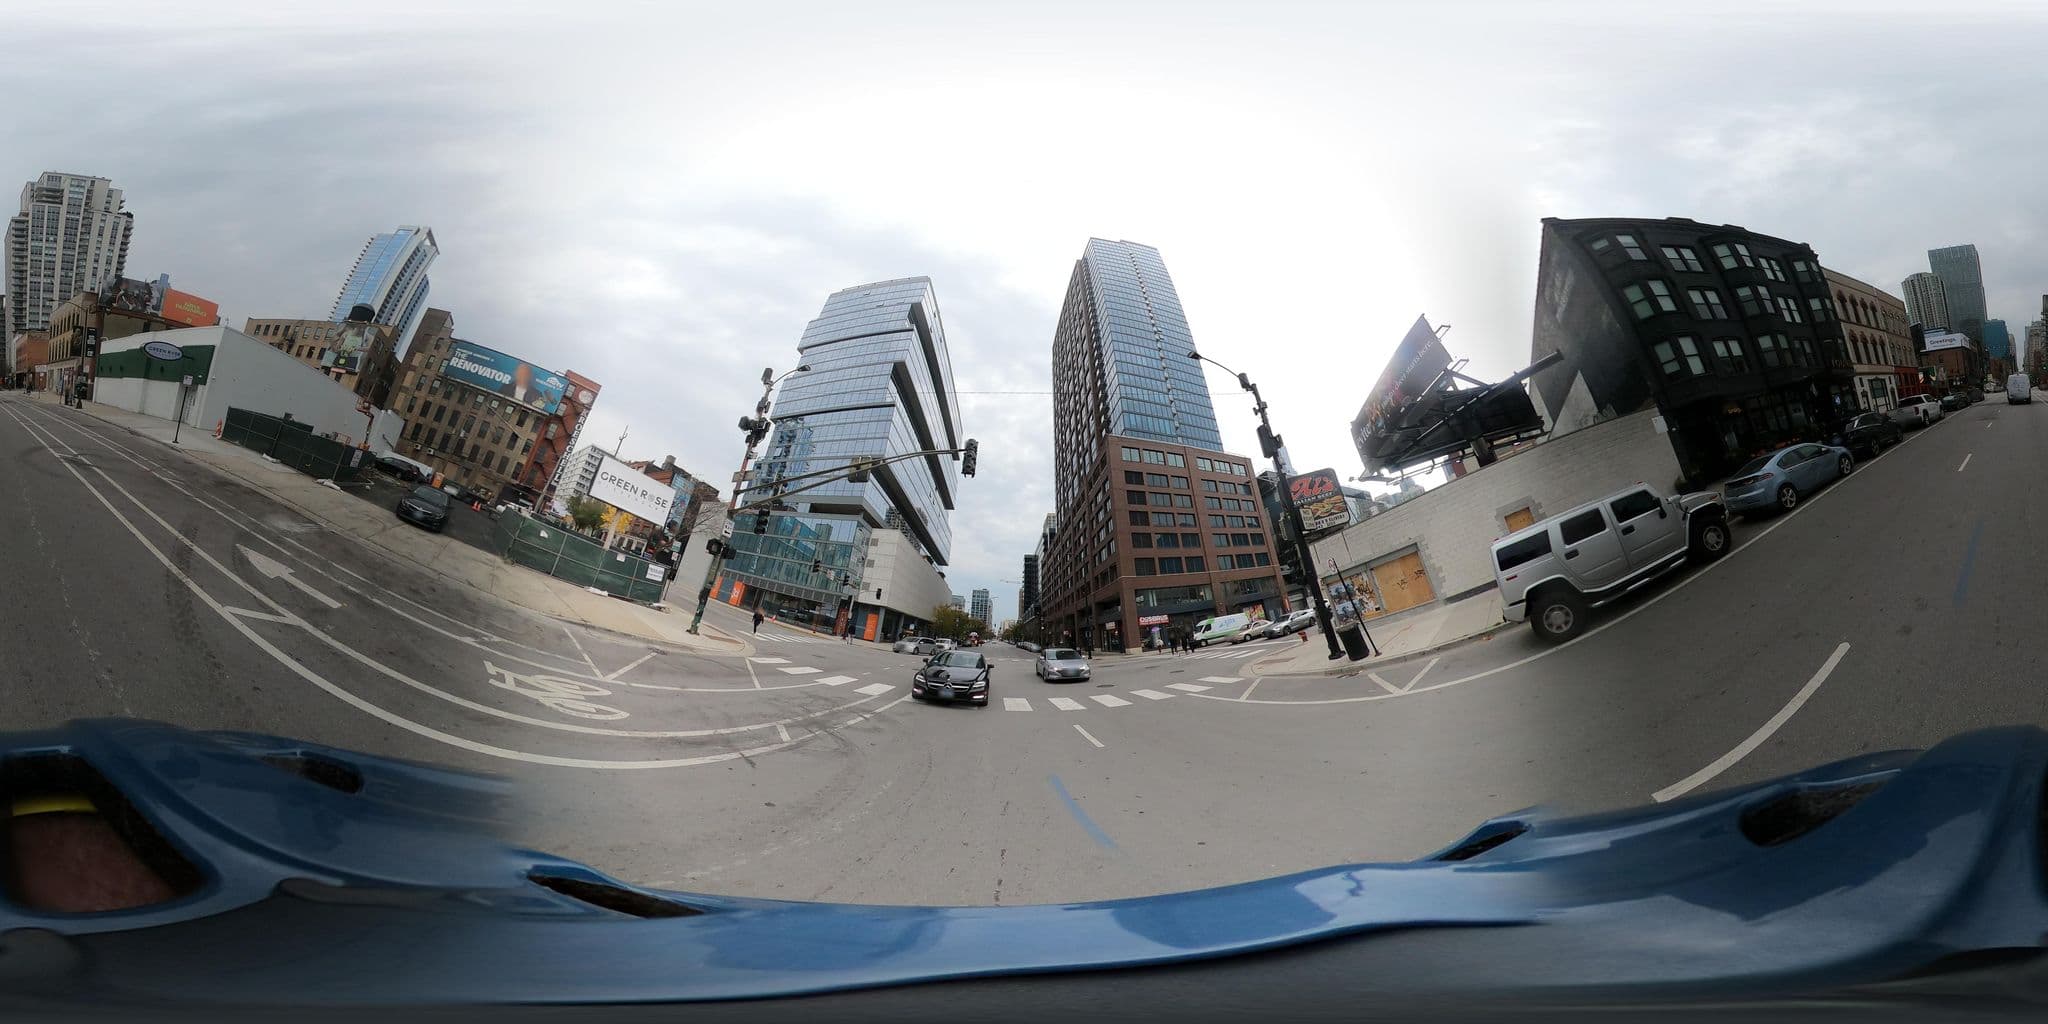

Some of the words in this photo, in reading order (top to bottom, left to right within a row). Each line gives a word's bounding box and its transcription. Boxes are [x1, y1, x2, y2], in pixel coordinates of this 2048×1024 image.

[454, 350, 469, 361] THE
[449, 357, 512, 385] RENOVATOR
[600, 472, 639, 496] GREEN
